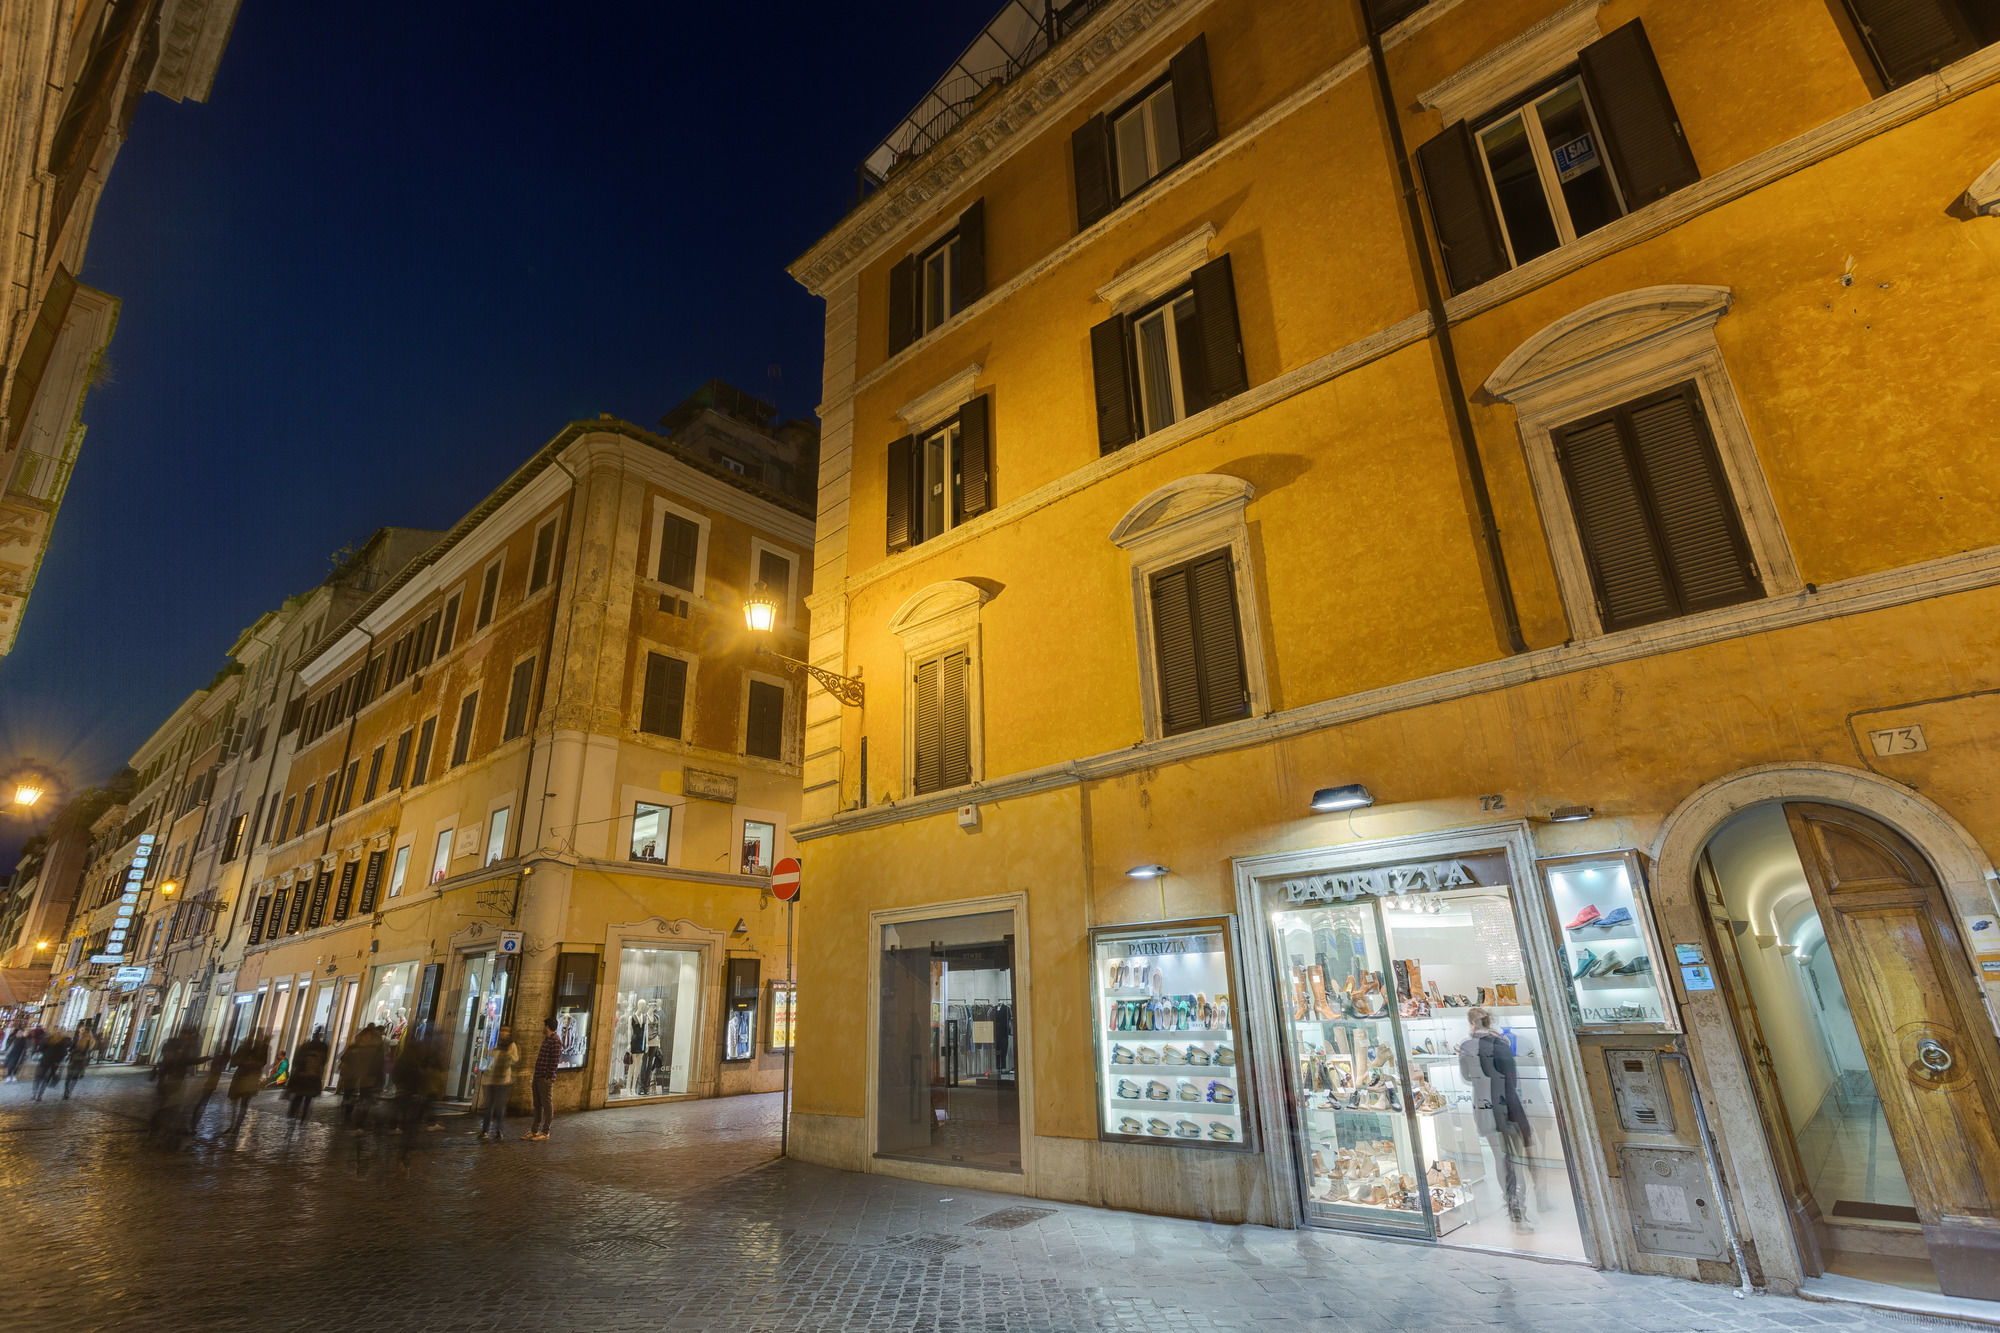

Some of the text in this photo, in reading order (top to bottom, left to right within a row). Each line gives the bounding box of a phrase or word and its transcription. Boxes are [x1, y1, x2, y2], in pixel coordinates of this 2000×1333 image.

[1878, 730, 1917, 752] 73
[1480, 795, 1504, 812] 72
[363, 855, 380, 910] FLAVIO CASTELLANI
[1285, 861, 1475, 901] PATRIZIA
[337, 865, 354, 918] FLAVIO CASTELLANI
[310, 906, 320, 925] FLAVIO
[1128, 941, 1186, 955] PATRIZIA
[1583, 1006, 1661, 1020] PATRIZIA
